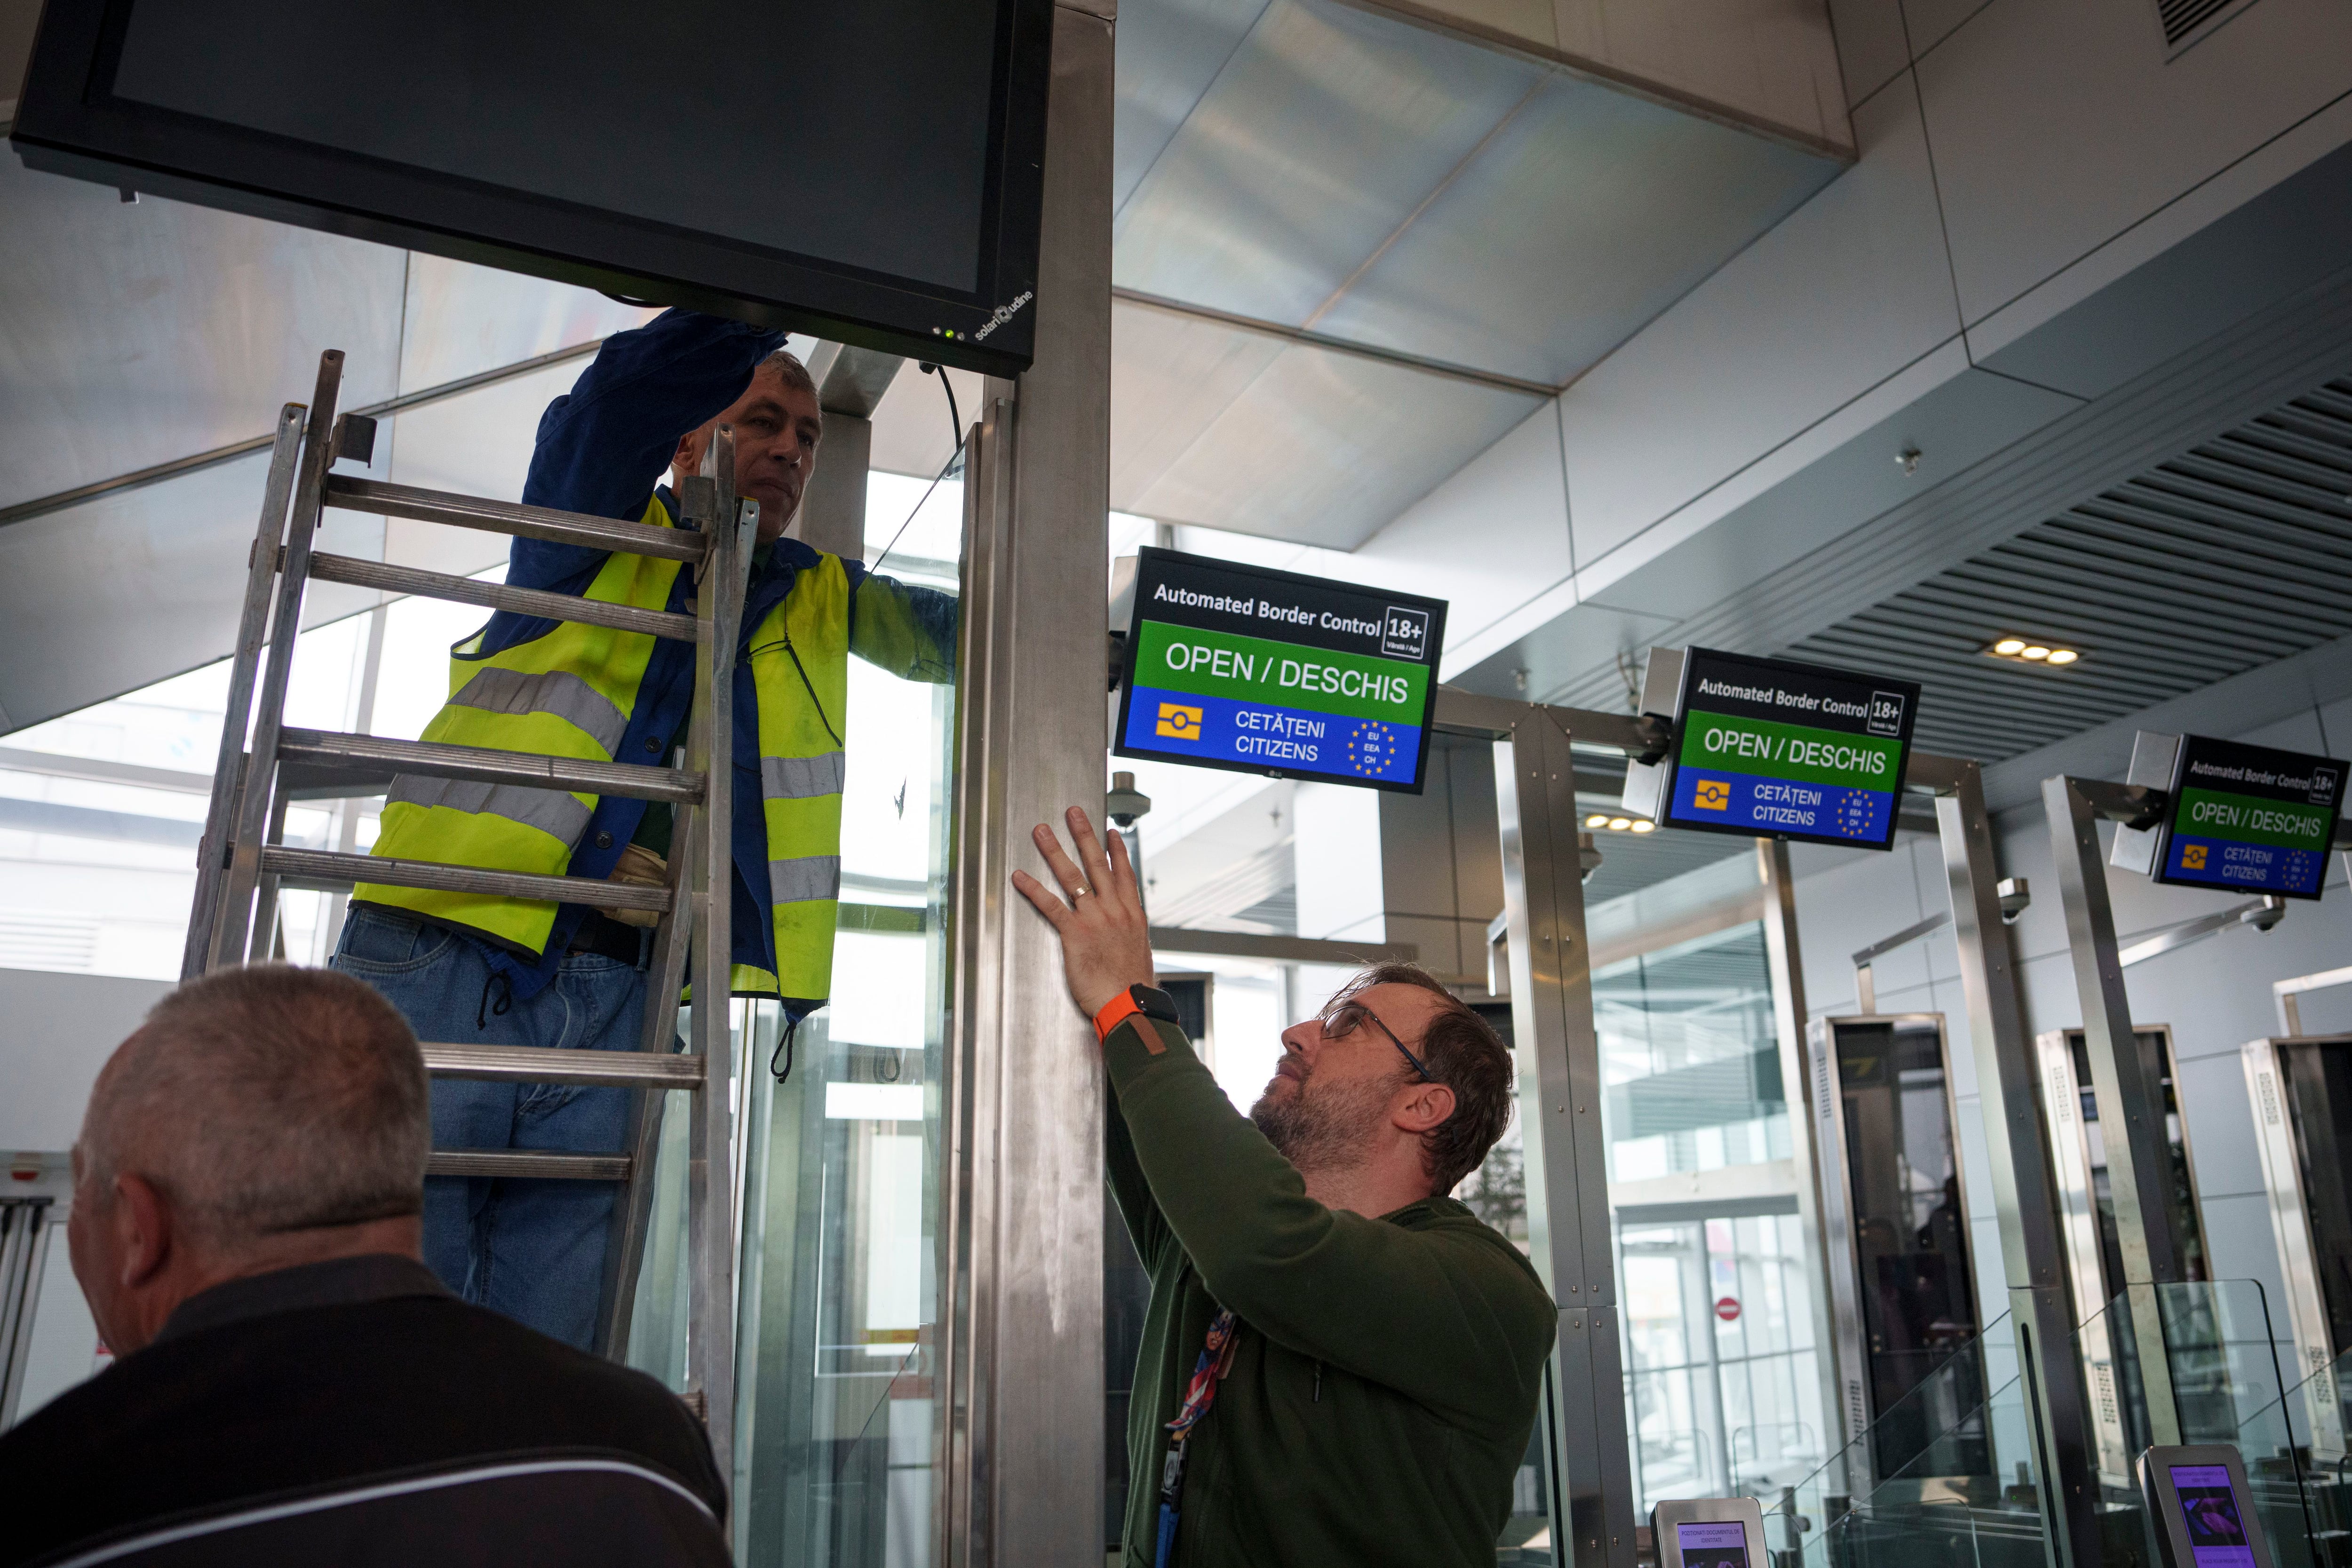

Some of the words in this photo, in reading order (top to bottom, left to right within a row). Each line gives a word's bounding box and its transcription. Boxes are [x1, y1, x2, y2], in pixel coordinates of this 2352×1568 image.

[975, 316, 1001, 341] solari
[1008, 291, 1033, 313] udine
[1154, 584, 1254, 615] Automated
[1258, 601, 1317, 626] Border
[1320, 612, 1382, 637] Control
[1388, 617, 1422, 638] 18+
[1166, 643, 1254, 681] OPEN
[1261, 657, 1273, 683] /
[1279, 659, 1408, 704] DESCHIS
[1699, 678, 1773, 703] Automated
[1776, 691, 1820, 710] Border
[1822, 698, 1868, 718] Control
[1873, 701, 1899, 718] 18+
[1235, 711, 1326, 739] CETĂȚENI
[1367, 732, 1379, 741] EU
[1235, 736, 1318, 762] CITIZENS
[1364, 743, 1380, 753] EEA
[1364, 755, 1376, 764] CH
[1705, 728, 1772, 760] OPEN
[1774, 738, 1786, 760] /
[1788, 740, 1886, 774] DESCHIS
[2190, 760, 2244, 780] Automated
[2244, 768, 2277, 786] Border
[2277, 773, 2312, 791] Control
[2314, 776, 2333, 790] 18+
[1753, 805, 1815, 826] CITIZENS
[2192, 801, 2240, 826] OPEN
[2241, 808, 2250, 828] /
[2251, 809, 2321, 837] DESCHIS
[2222, 864, 2267, 882] CITIZENS
